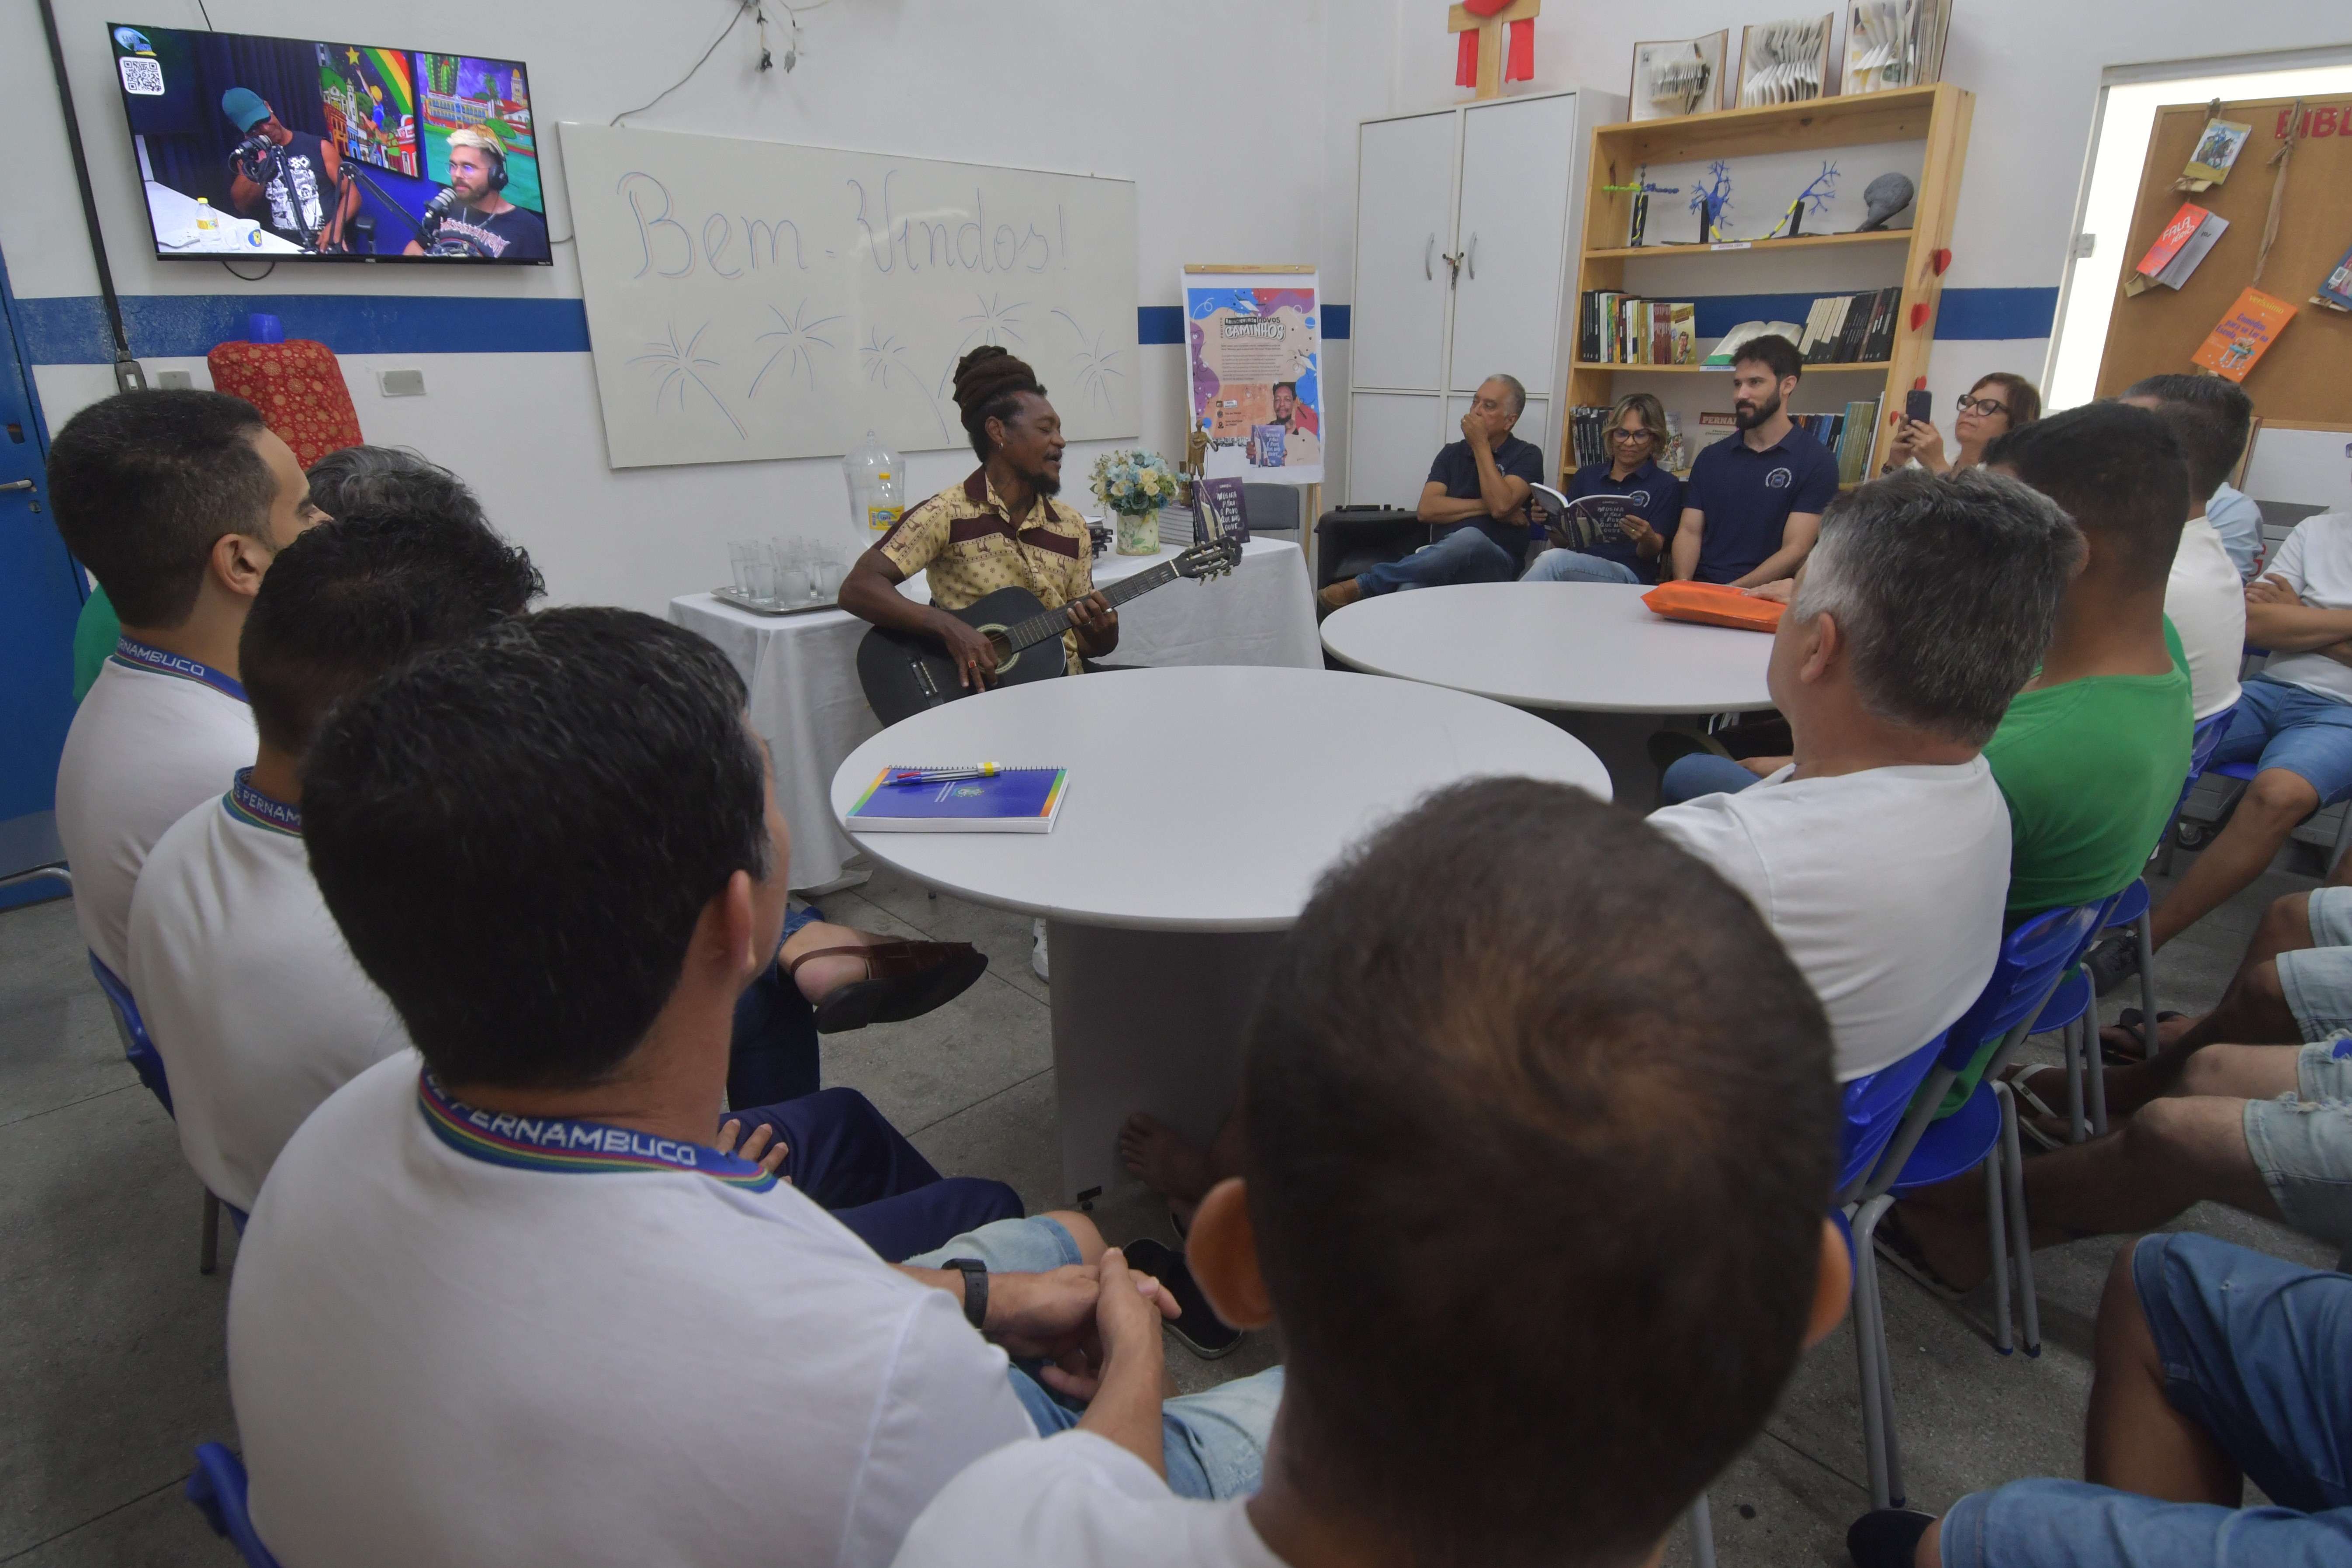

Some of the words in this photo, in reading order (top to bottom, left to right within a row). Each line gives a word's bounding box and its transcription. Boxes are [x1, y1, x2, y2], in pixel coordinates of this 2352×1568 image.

[2162, 216, 2191, 241] FALA
[1225, 322, 1286, 342] CAMINHOS
[1702, 416, 1737, 425] PERNA
[1223, 500, 1235, 508] PARA
[1225, 523, 1238, 532] OUVE
[118, 637, 205, 677] RNAMBUCO
[242, 789, 302, 826] PERNAM
